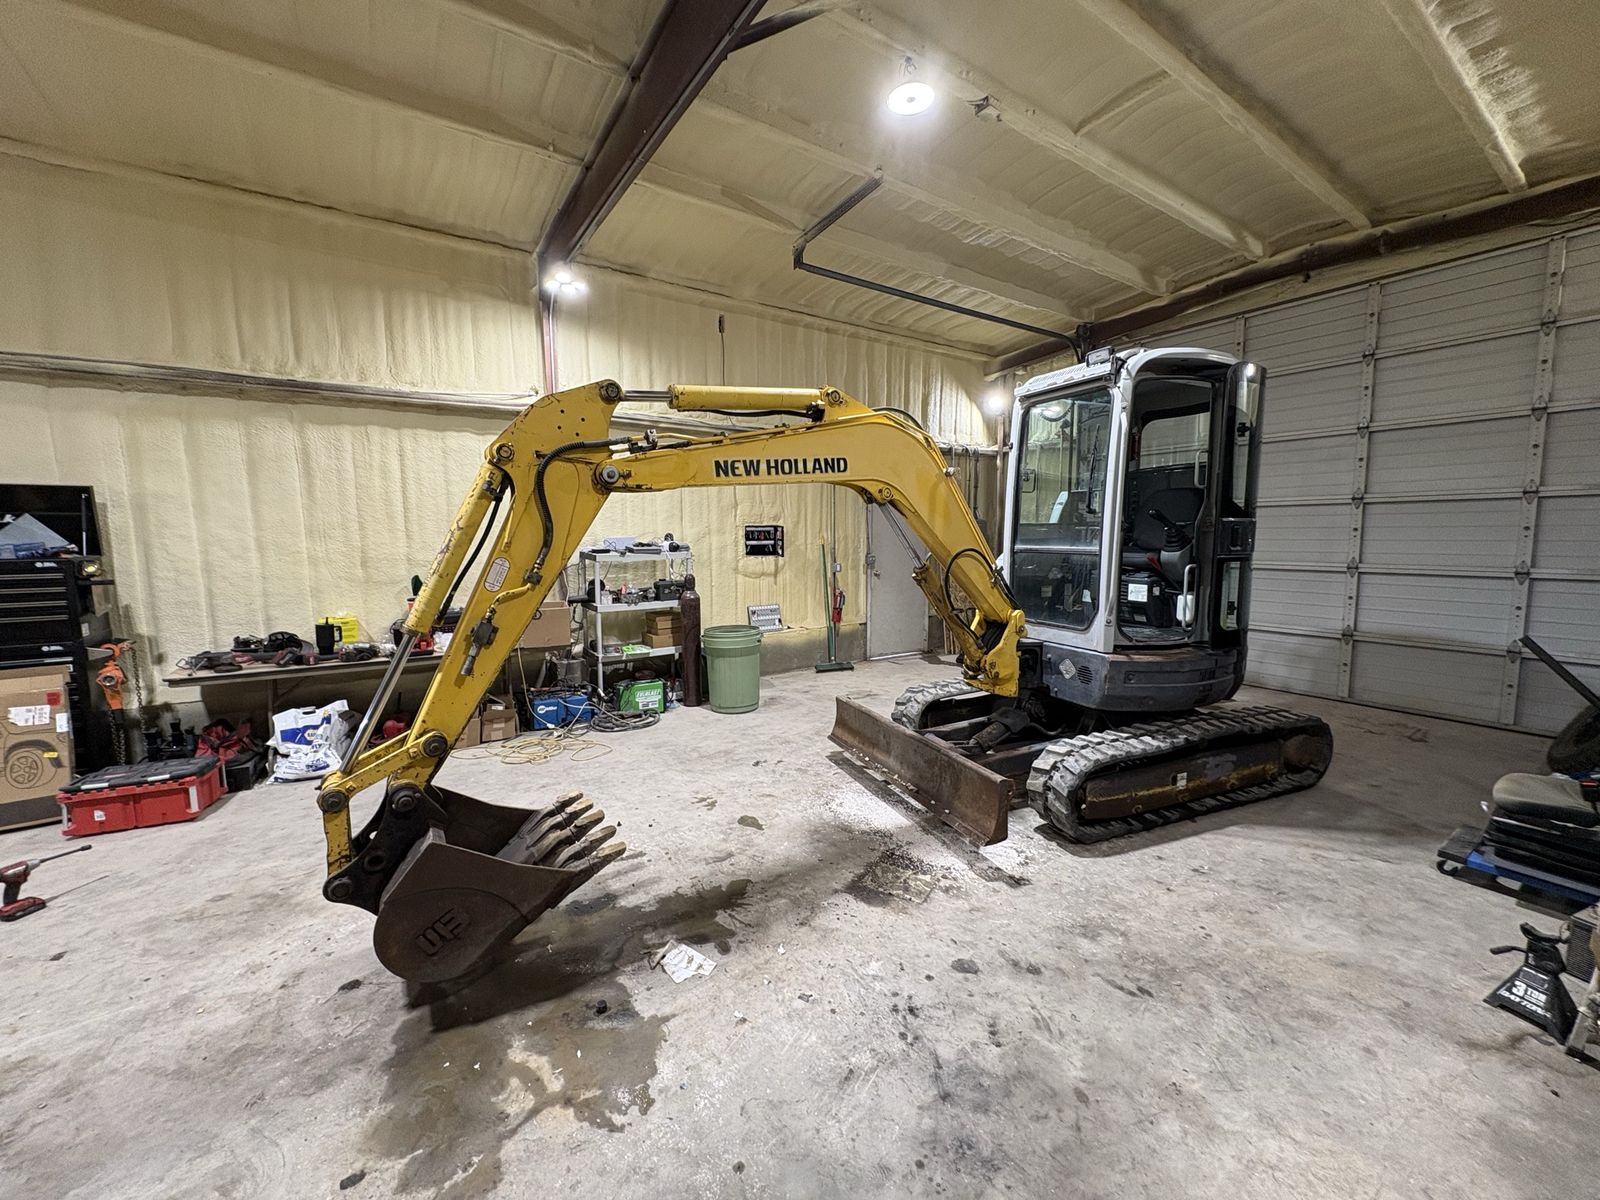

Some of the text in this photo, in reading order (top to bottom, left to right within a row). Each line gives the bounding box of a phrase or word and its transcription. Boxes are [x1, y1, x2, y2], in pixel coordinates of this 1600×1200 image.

[714, 457, 848, 478] NEW HOLLAND
[1511, 980, 1527, 998] 3
[1526, 987, 1548, 1003] TON
